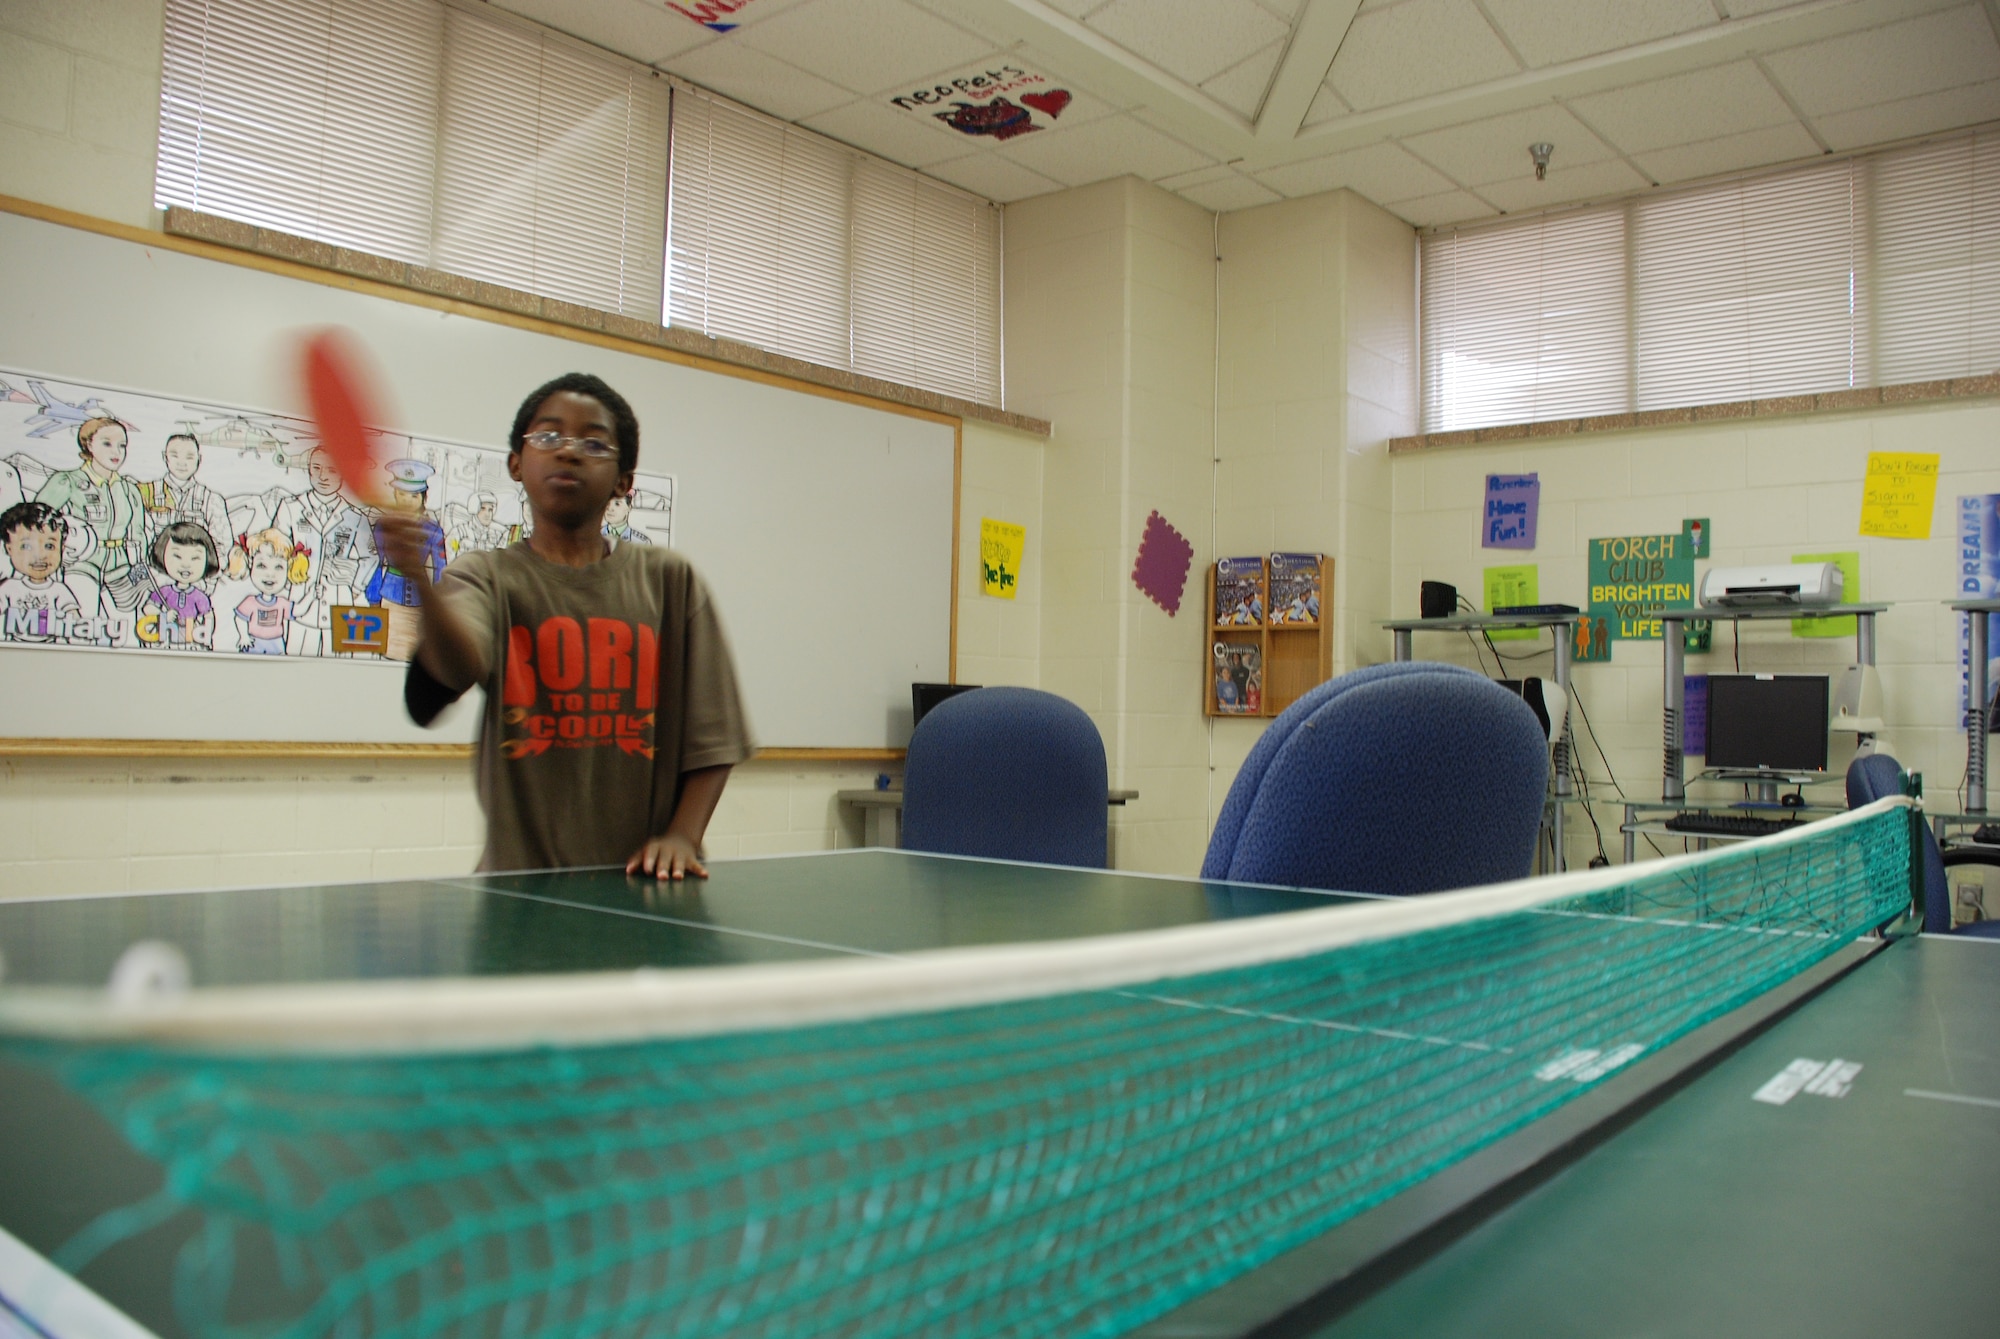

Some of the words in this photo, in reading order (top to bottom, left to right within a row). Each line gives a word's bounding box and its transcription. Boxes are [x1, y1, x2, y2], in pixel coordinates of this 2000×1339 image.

[1867, 490, 1898, 505] Sign
[1490, 517, 1525, 542] Fun!
[1598, 535, 1675, 561] TORCH
[1963, 498, 1981, 593] DREAMS
[1609, 560, 1665, 583] CLUB
[1592, 583, 1690, 603] BRIGHTEN
[6, 606, 128, 648] Military
[1621, 620, 1664, 637] LIFE
[550, 693, 584, 711] TO
[590, 692, 621, 711] BE
[529, 714, 640, 740] COOL
